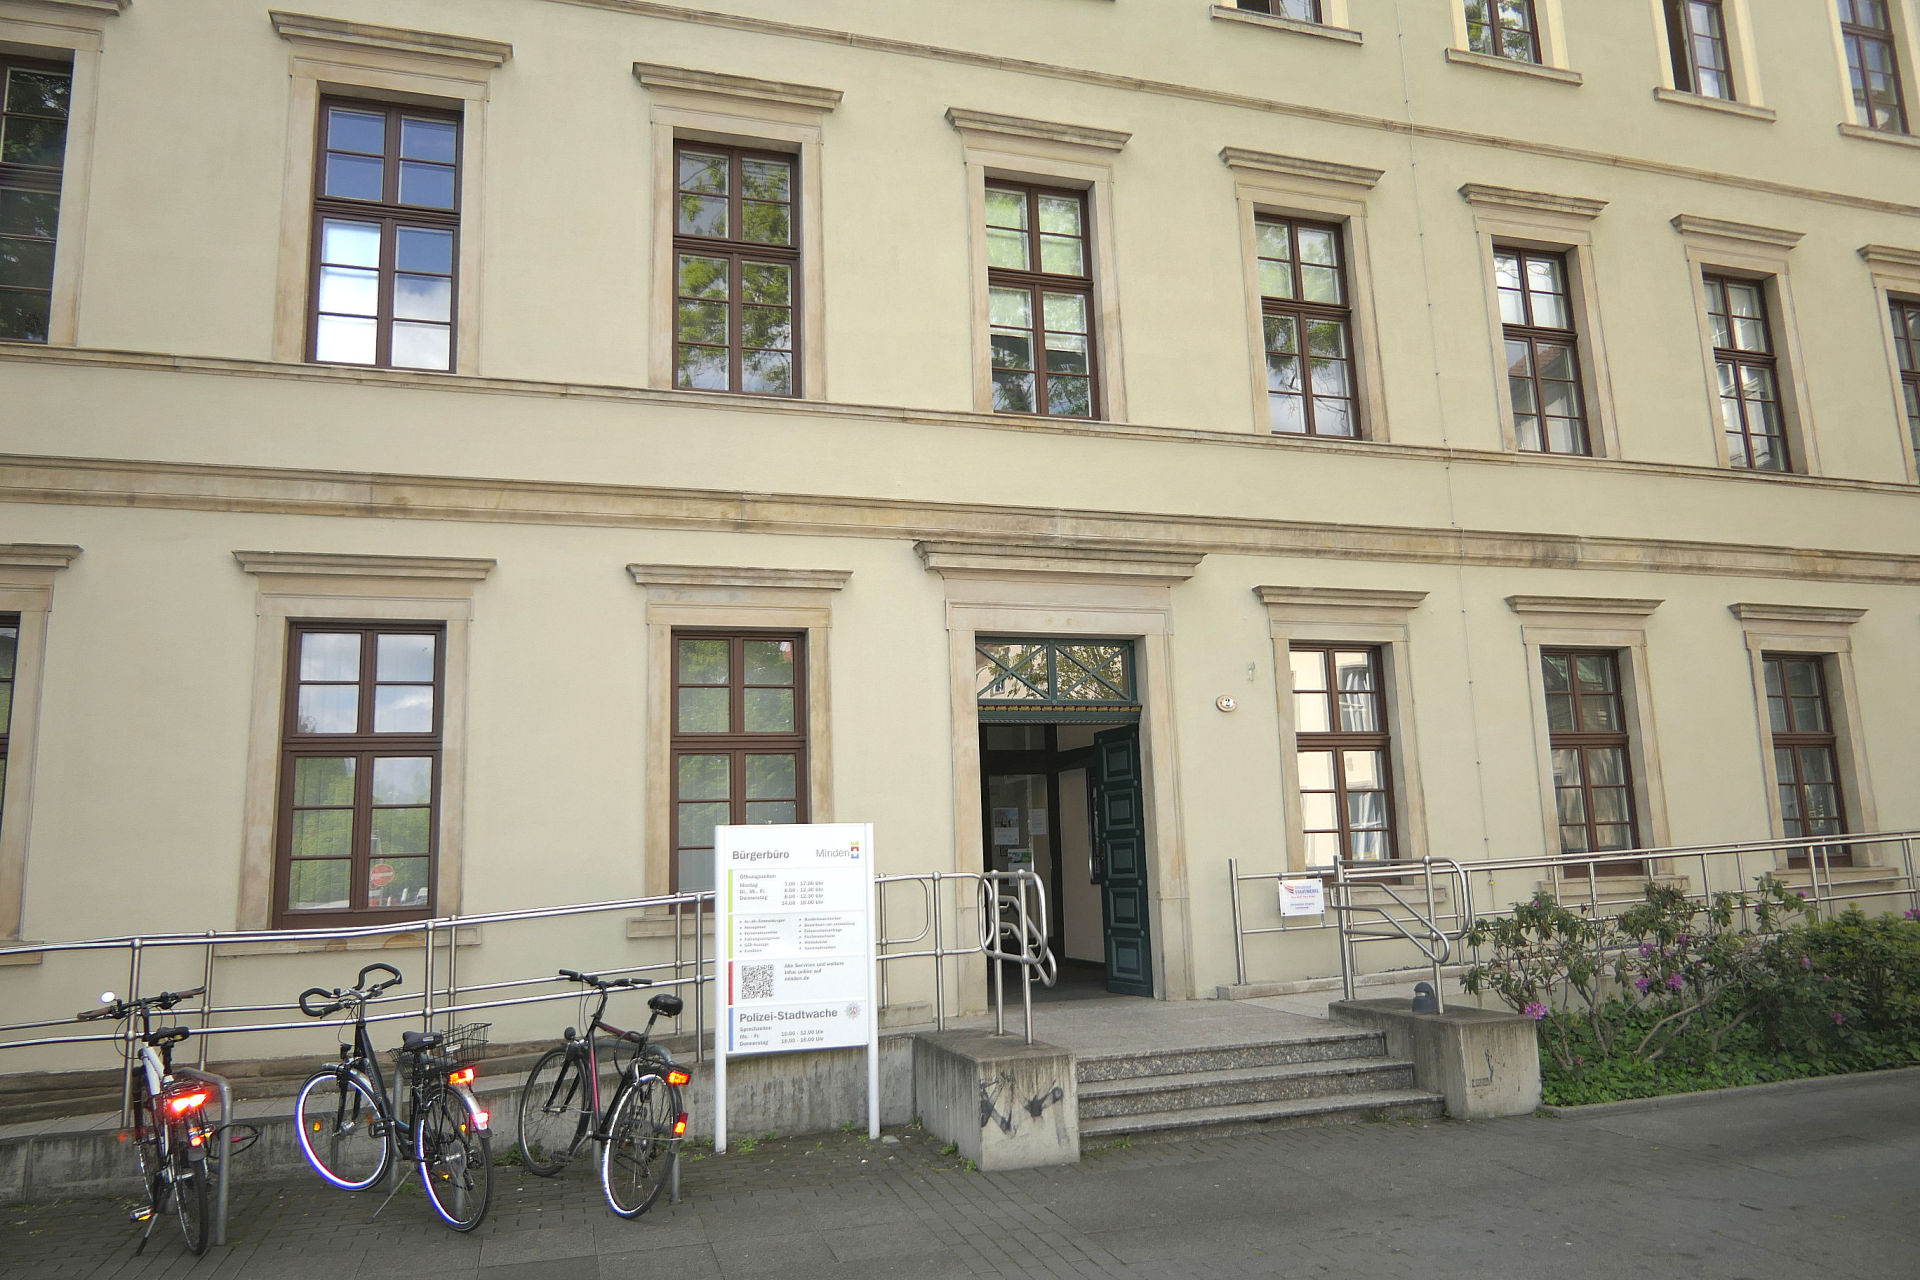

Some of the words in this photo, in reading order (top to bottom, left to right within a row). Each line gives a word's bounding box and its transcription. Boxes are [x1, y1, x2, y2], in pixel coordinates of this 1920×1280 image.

[1225, 697, 1231, 706] 2
[732, 850, 790, 861] Bürgerbüro
[816, 849, 850, 858] Minden
[739, 1008, 838, 1022] Polizei-Stadtwache
